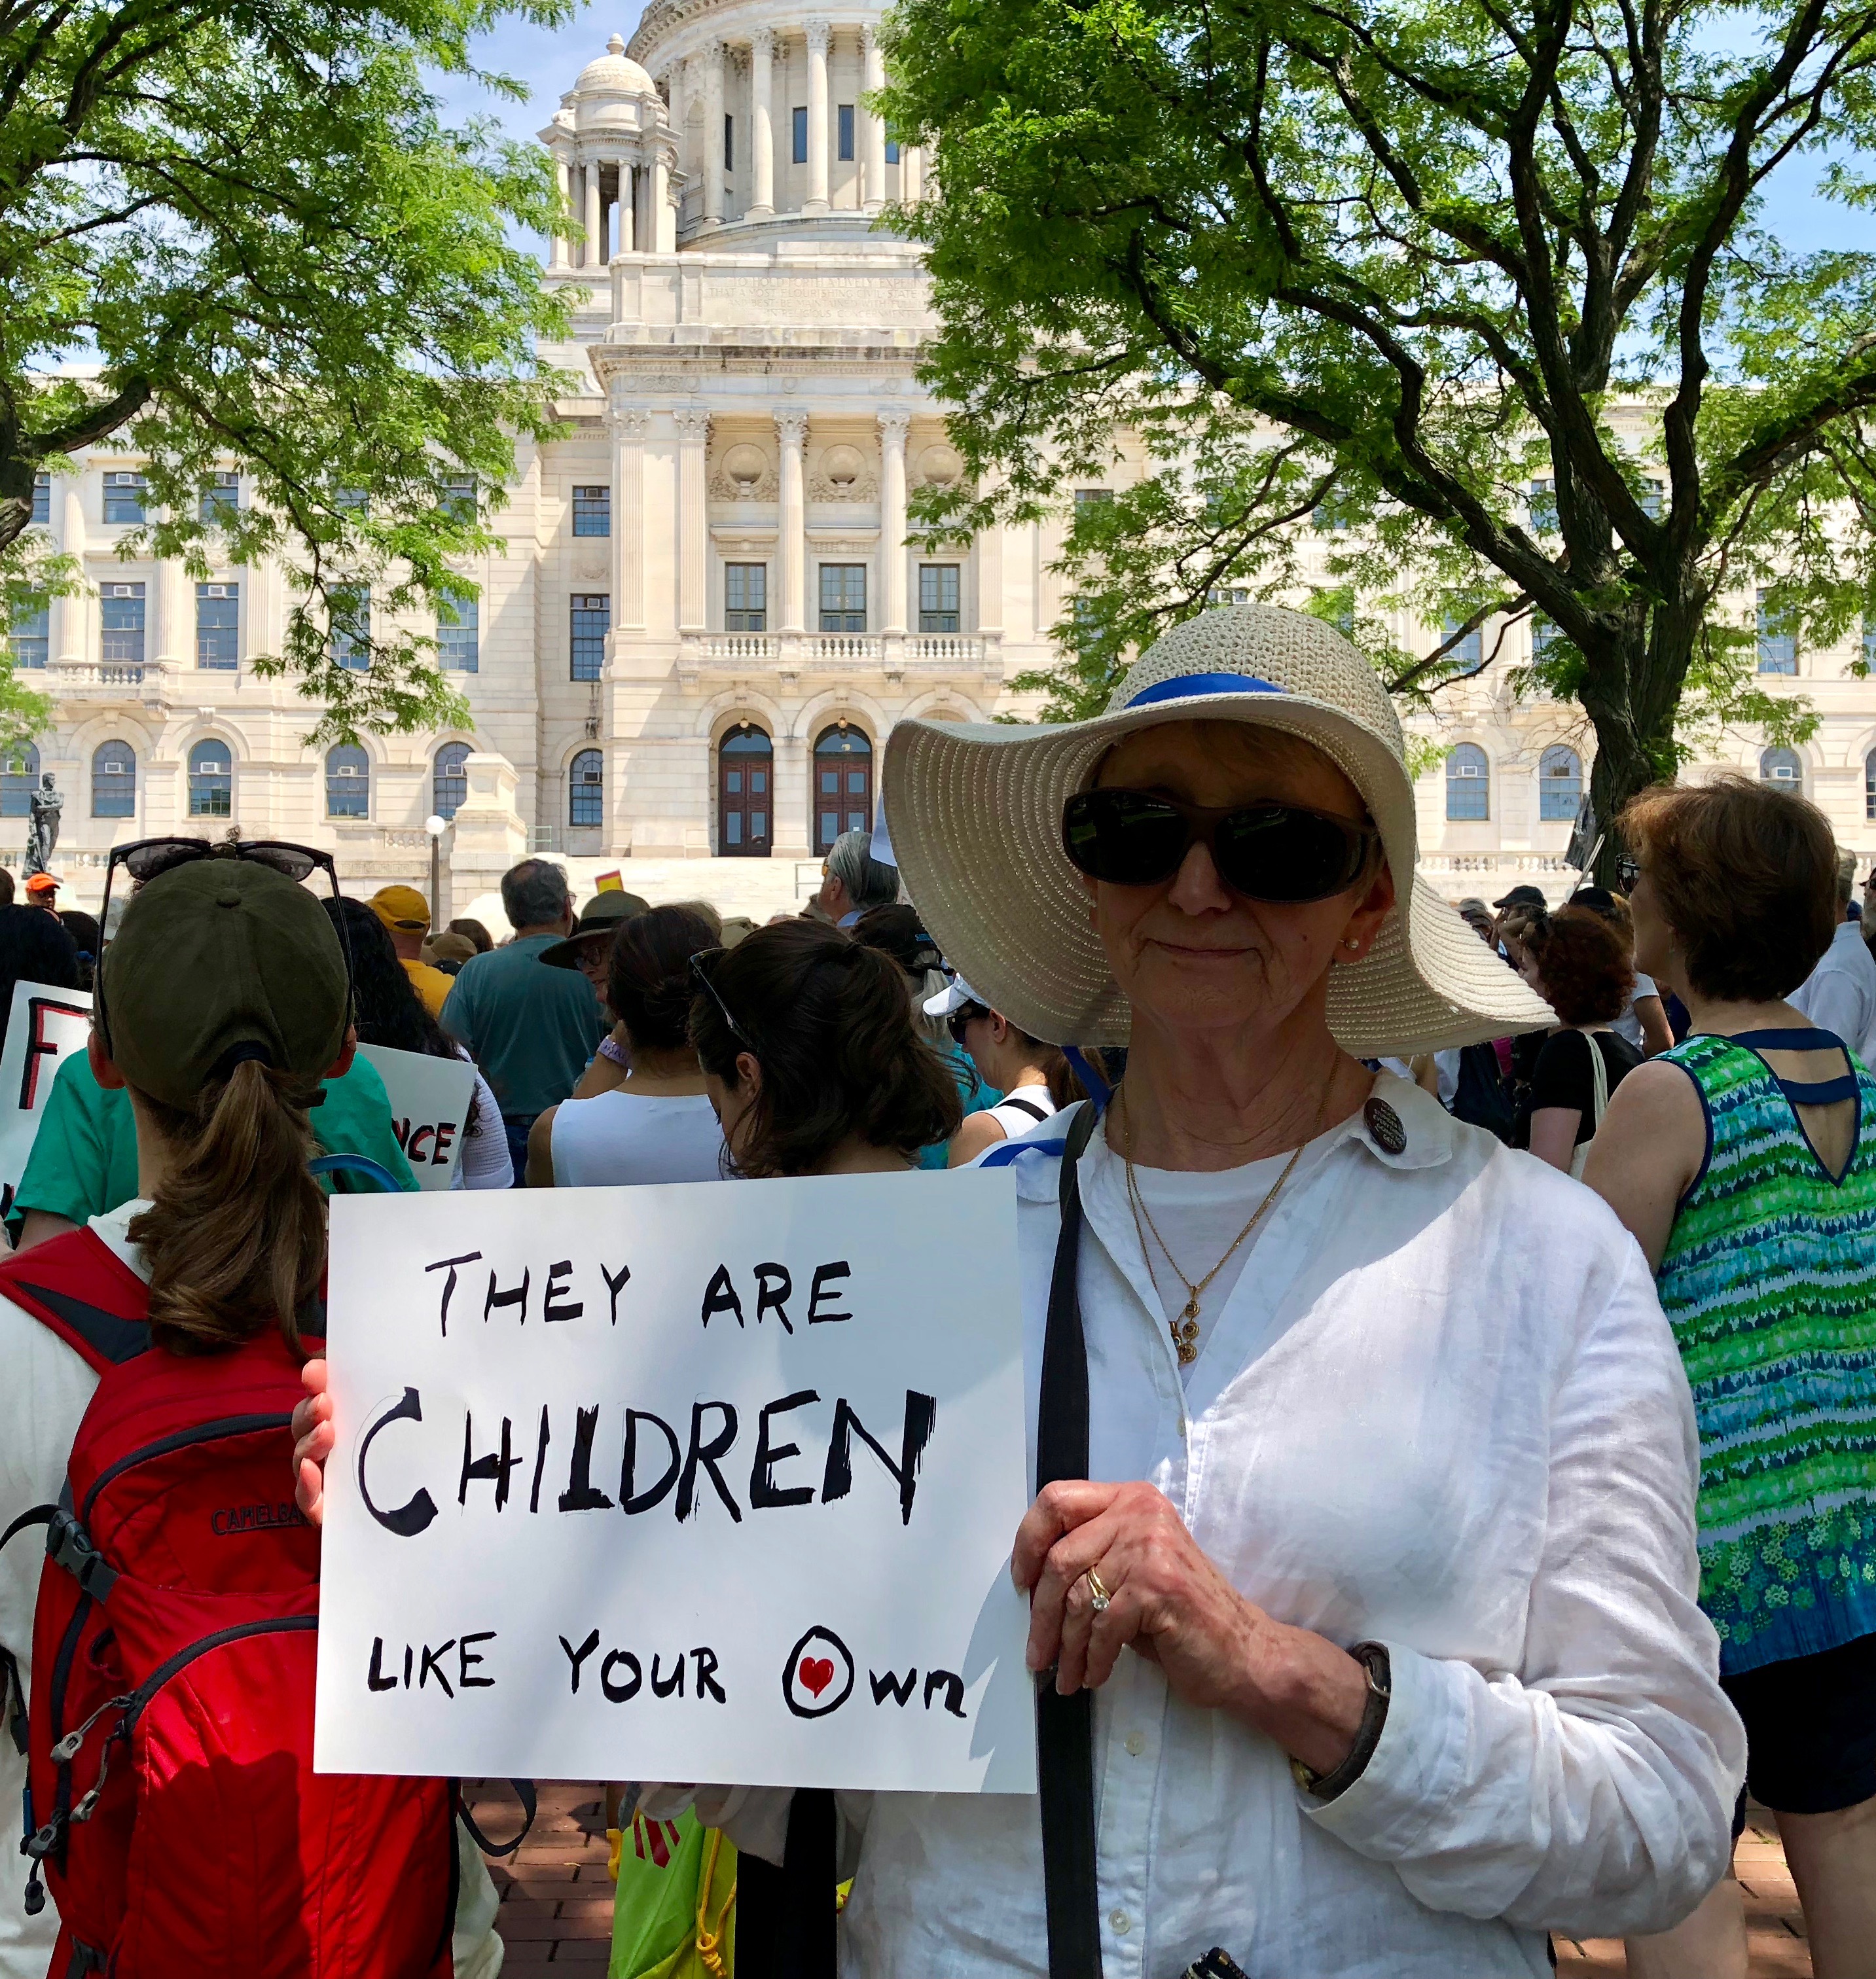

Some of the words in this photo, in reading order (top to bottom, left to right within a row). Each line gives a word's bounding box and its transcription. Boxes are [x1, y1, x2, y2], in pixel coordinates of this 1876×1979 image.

[708, 288, 736, 297] THAT
[781, 289, 853, 298] FLOURISHING
[857, 289, 882, 298] CIVIL
[888, 289, 916, 298] STATE
[752, 277, 784, 287] HOLD
[780, 299, 792, 308] BE
[391, 1117, 457, 1166] NCE
[425, 1251, 631, 1337] THEY
[702, 1260, 854, 1334] ARE
[358, 1386, 937, 1537] CHILDREN
[211, 1503, 306, 1535] CAMELBA
[367, 1631, 497, 1699] LIKE
[558, 1628, 727, 1704] YOUR
